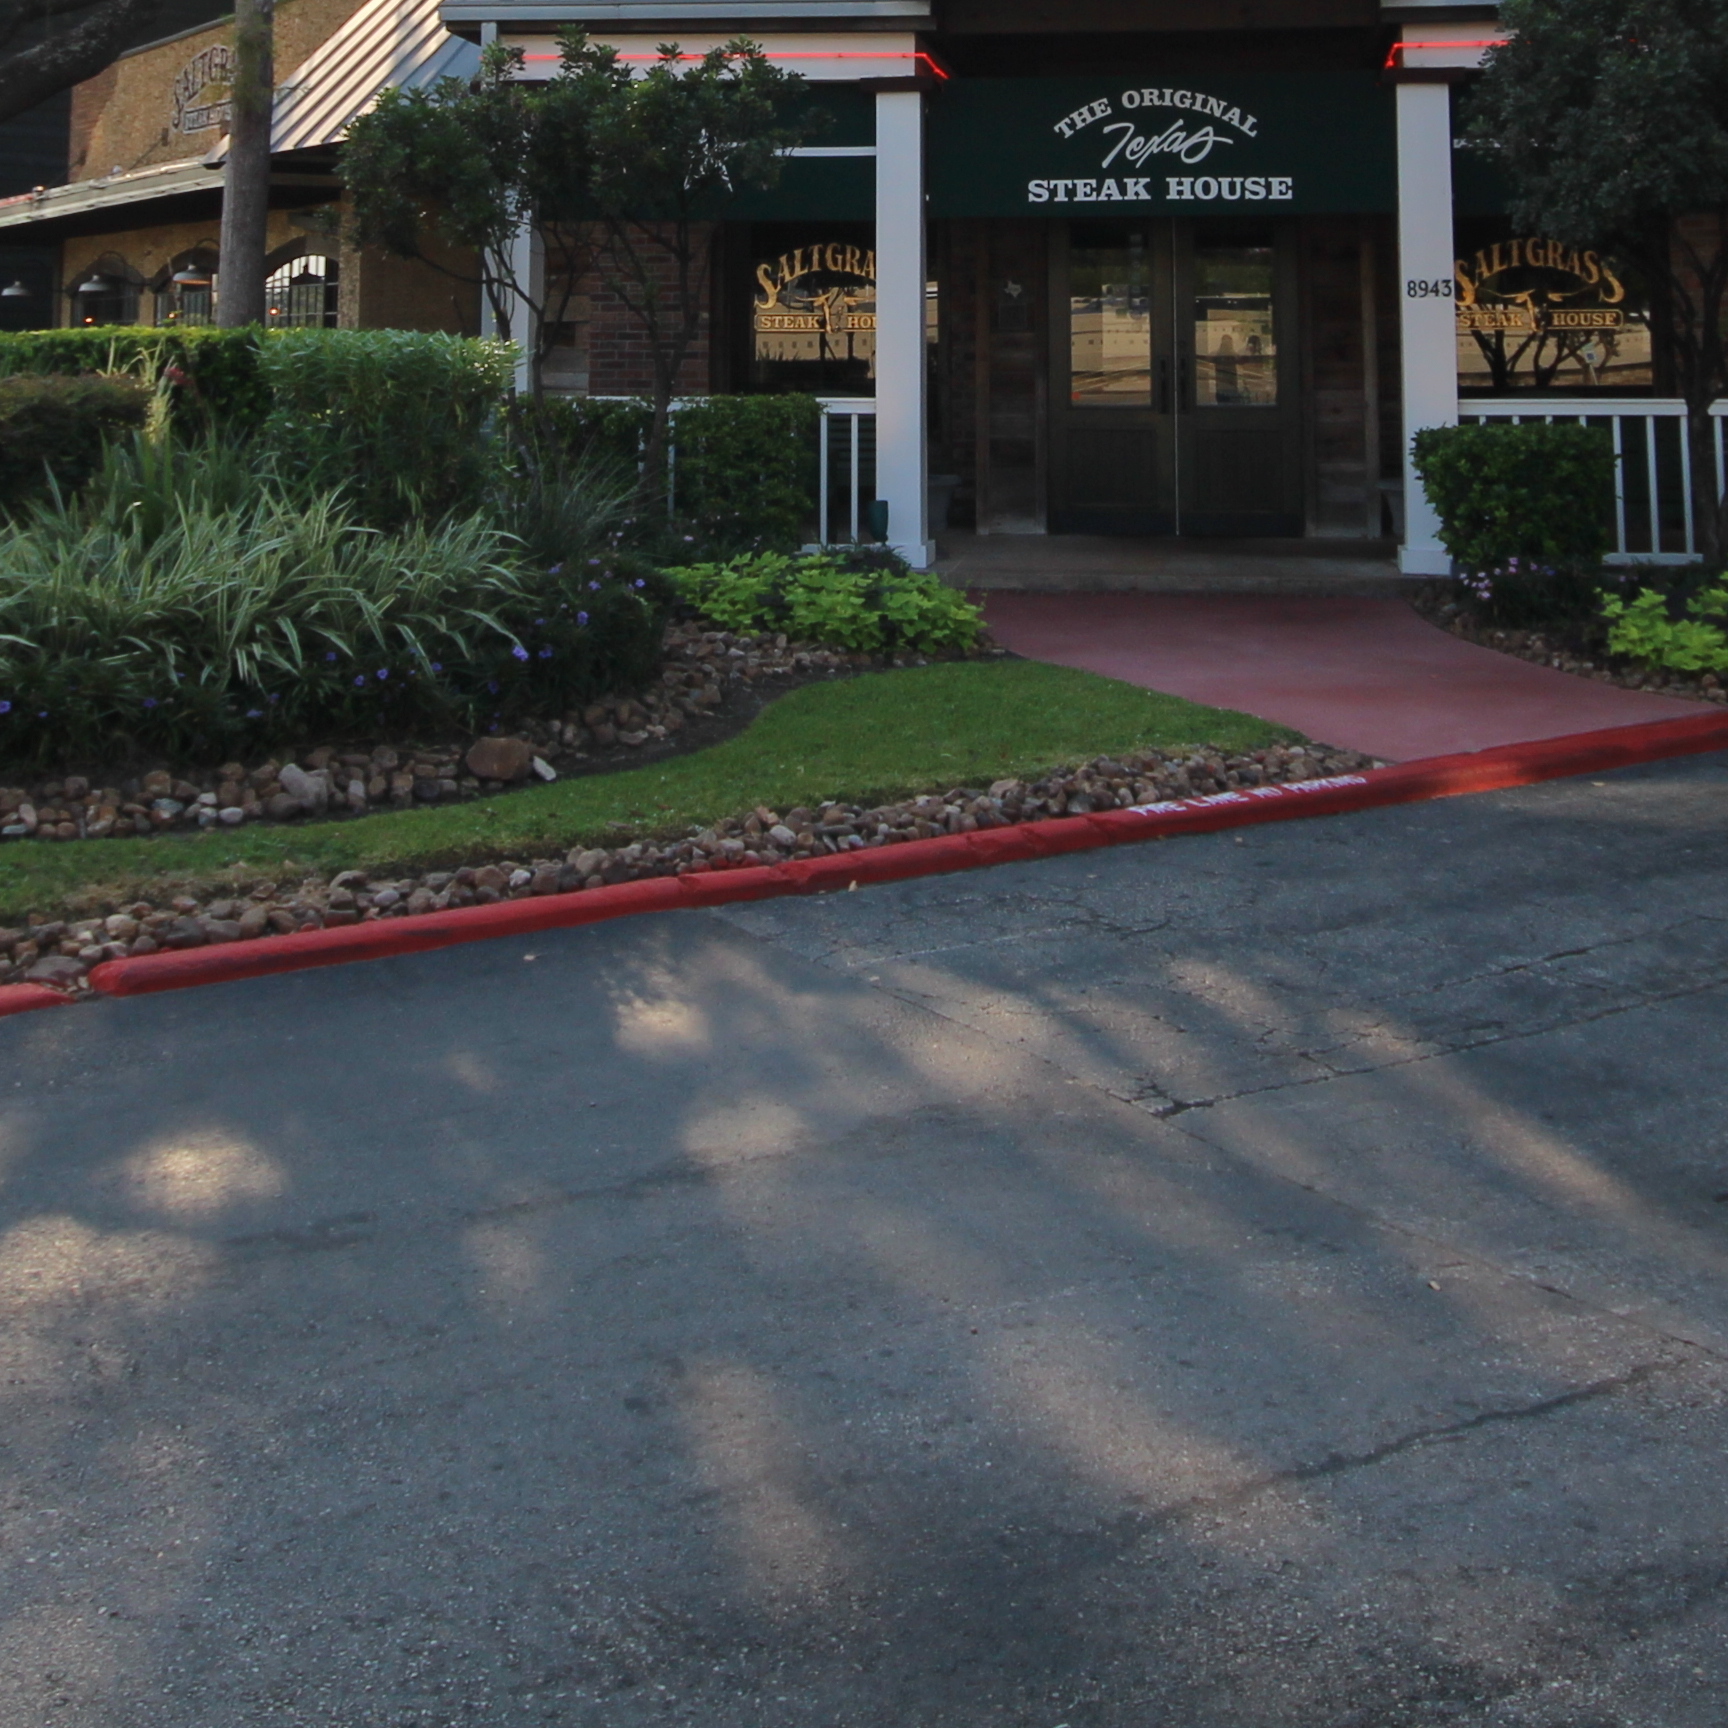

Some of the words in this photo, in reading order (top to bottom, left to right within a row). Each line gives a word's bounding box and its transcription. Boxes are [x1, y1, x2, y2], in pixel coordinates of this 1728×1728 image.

[1053, 97, 1113, 139] THE
[1121, 88, 1258, 138] ORIGINAL
[1101, 119, 1234, 169] Texas
[1028, 178, 1151, 202] STEAK
[1165, 176, 1293, 200] HOUSE
[754, 242, 876, 309] SALTGRA
[1407, 280, 1452, 297] 8943
[1454, 237, 1625, 306] SALTGRASS
[761, 316, 820, 329] STEAK
[1459, 313, 1522, 327] STEAK
[1552, 313, 1617, 326] HOUSE
